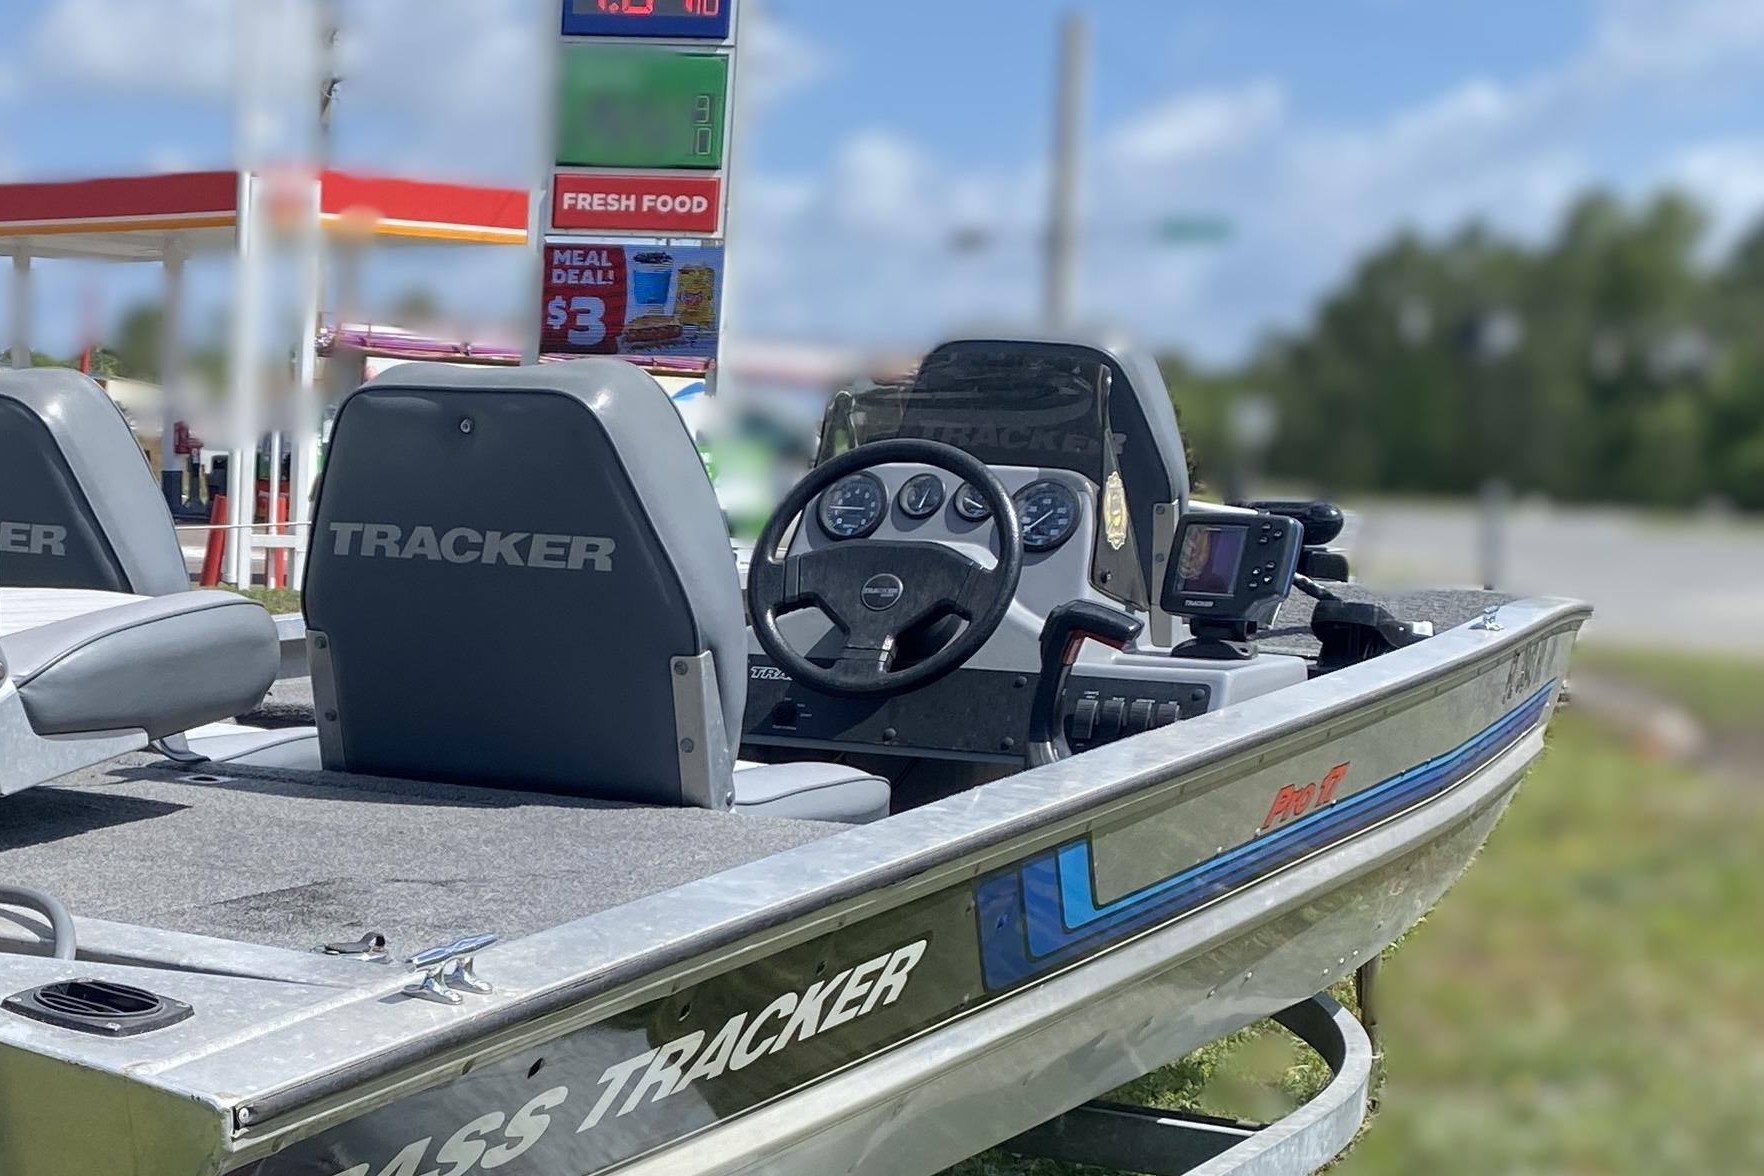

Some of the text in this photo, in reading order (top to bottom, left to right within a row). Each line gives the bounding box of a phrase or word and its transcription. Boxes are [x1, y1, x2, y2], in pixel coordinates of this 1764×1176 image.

[562, 192, 709, 214] FRESH FOOD
[552, 249, 613, 267] MEAL
[551, 269, 615, 285] DEAL!
[546, 295, 606, 346] $3
[329, 521, 616, 573] TRACKER
[577, 939, 928, 1133] TRACKER
